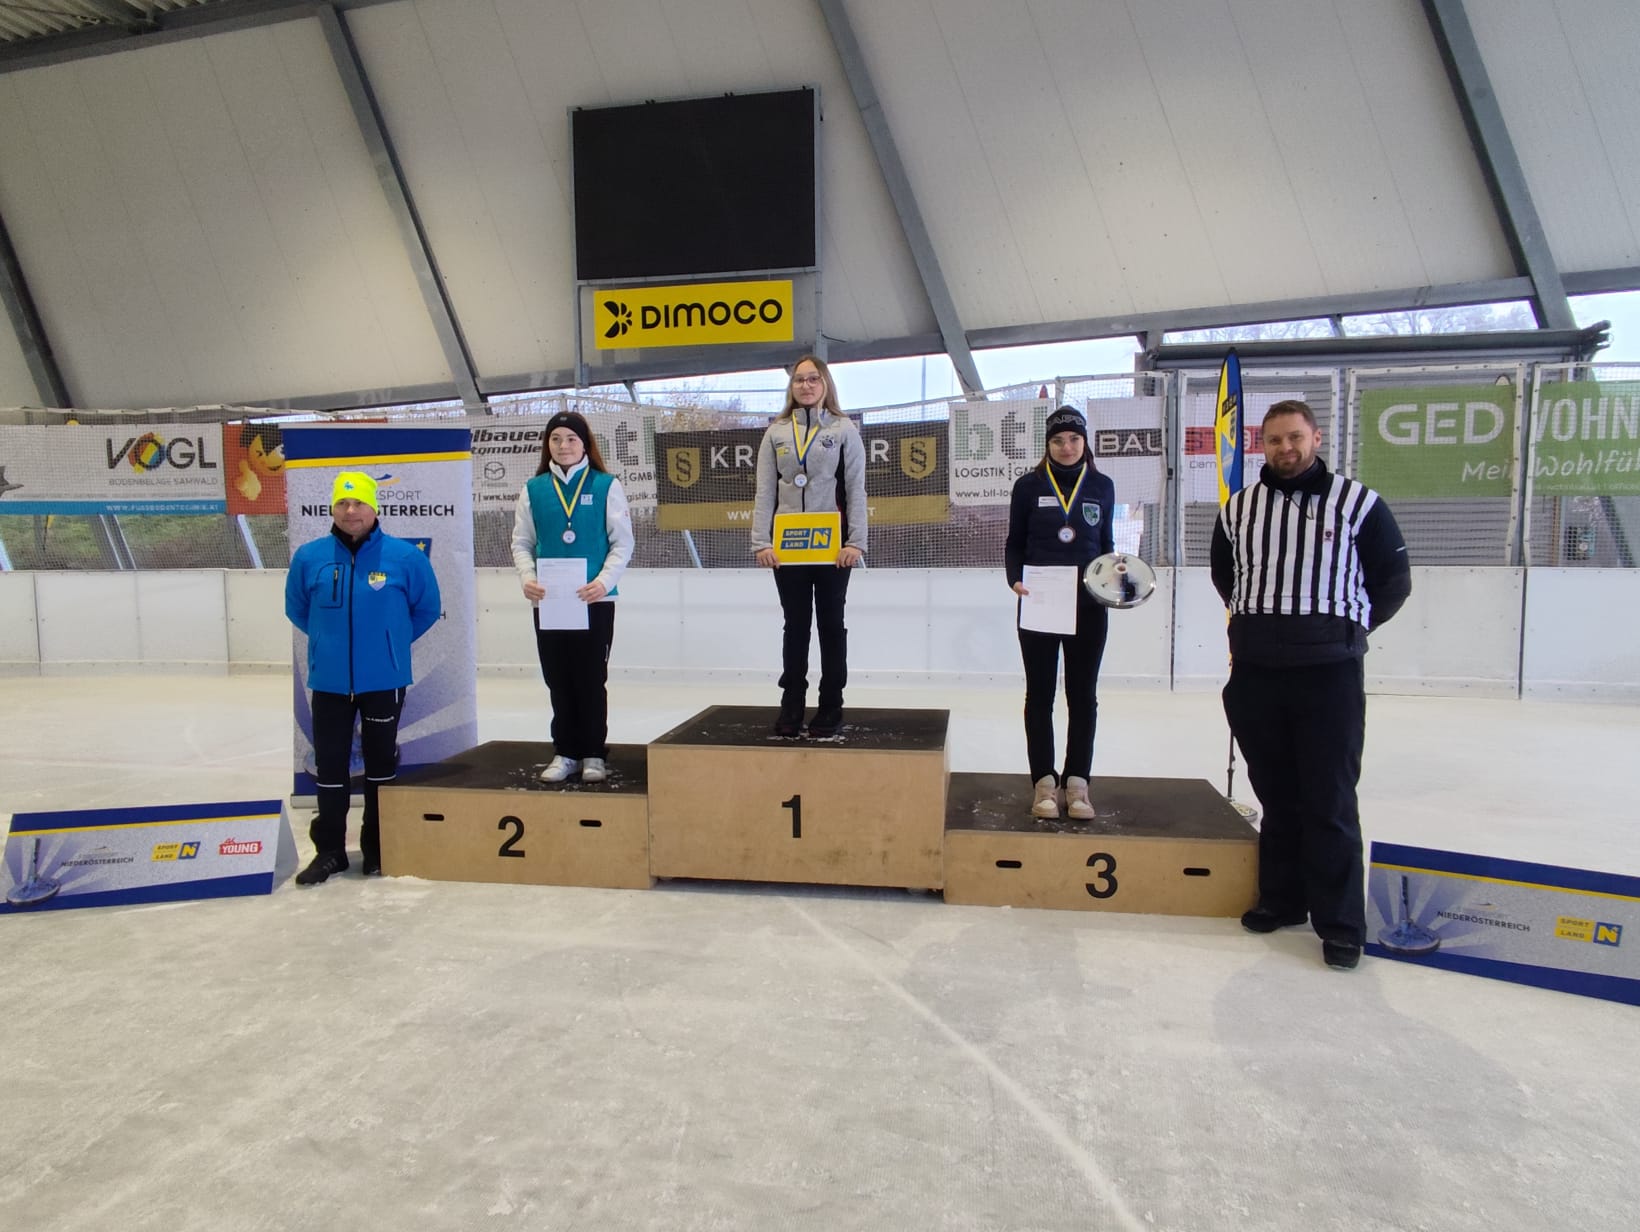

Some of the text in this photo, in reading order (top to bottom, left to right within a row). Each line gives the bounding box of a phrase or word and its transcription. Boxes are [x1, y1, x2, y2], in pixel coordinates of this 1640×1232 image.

[641, 299, 783, 329] DIMOCO
[1378, 400, 1505, 445] GED
[472, 429, 545, 443] lbauer
[106, 436, 217, 470] VOGL
[471, 444, 543, 455] tomobile
[711, 445, 753, 468] KR
[955, 466, 1035, 478] LOGISTIK GM
[376, 490, 422, 501] SPORT
[782, 795, 801, 838] 1
[498, 816, 525, 857] 2
[222, 843, 259, 854] YOUNG
[1086, 852, 1117, 898] 3
[1437, 910, 1531, 933] NIEDERÖSTERREICH
[1560, 917, 1590, 928] SPORT
[1560, 929, 1585, 939] LAND
